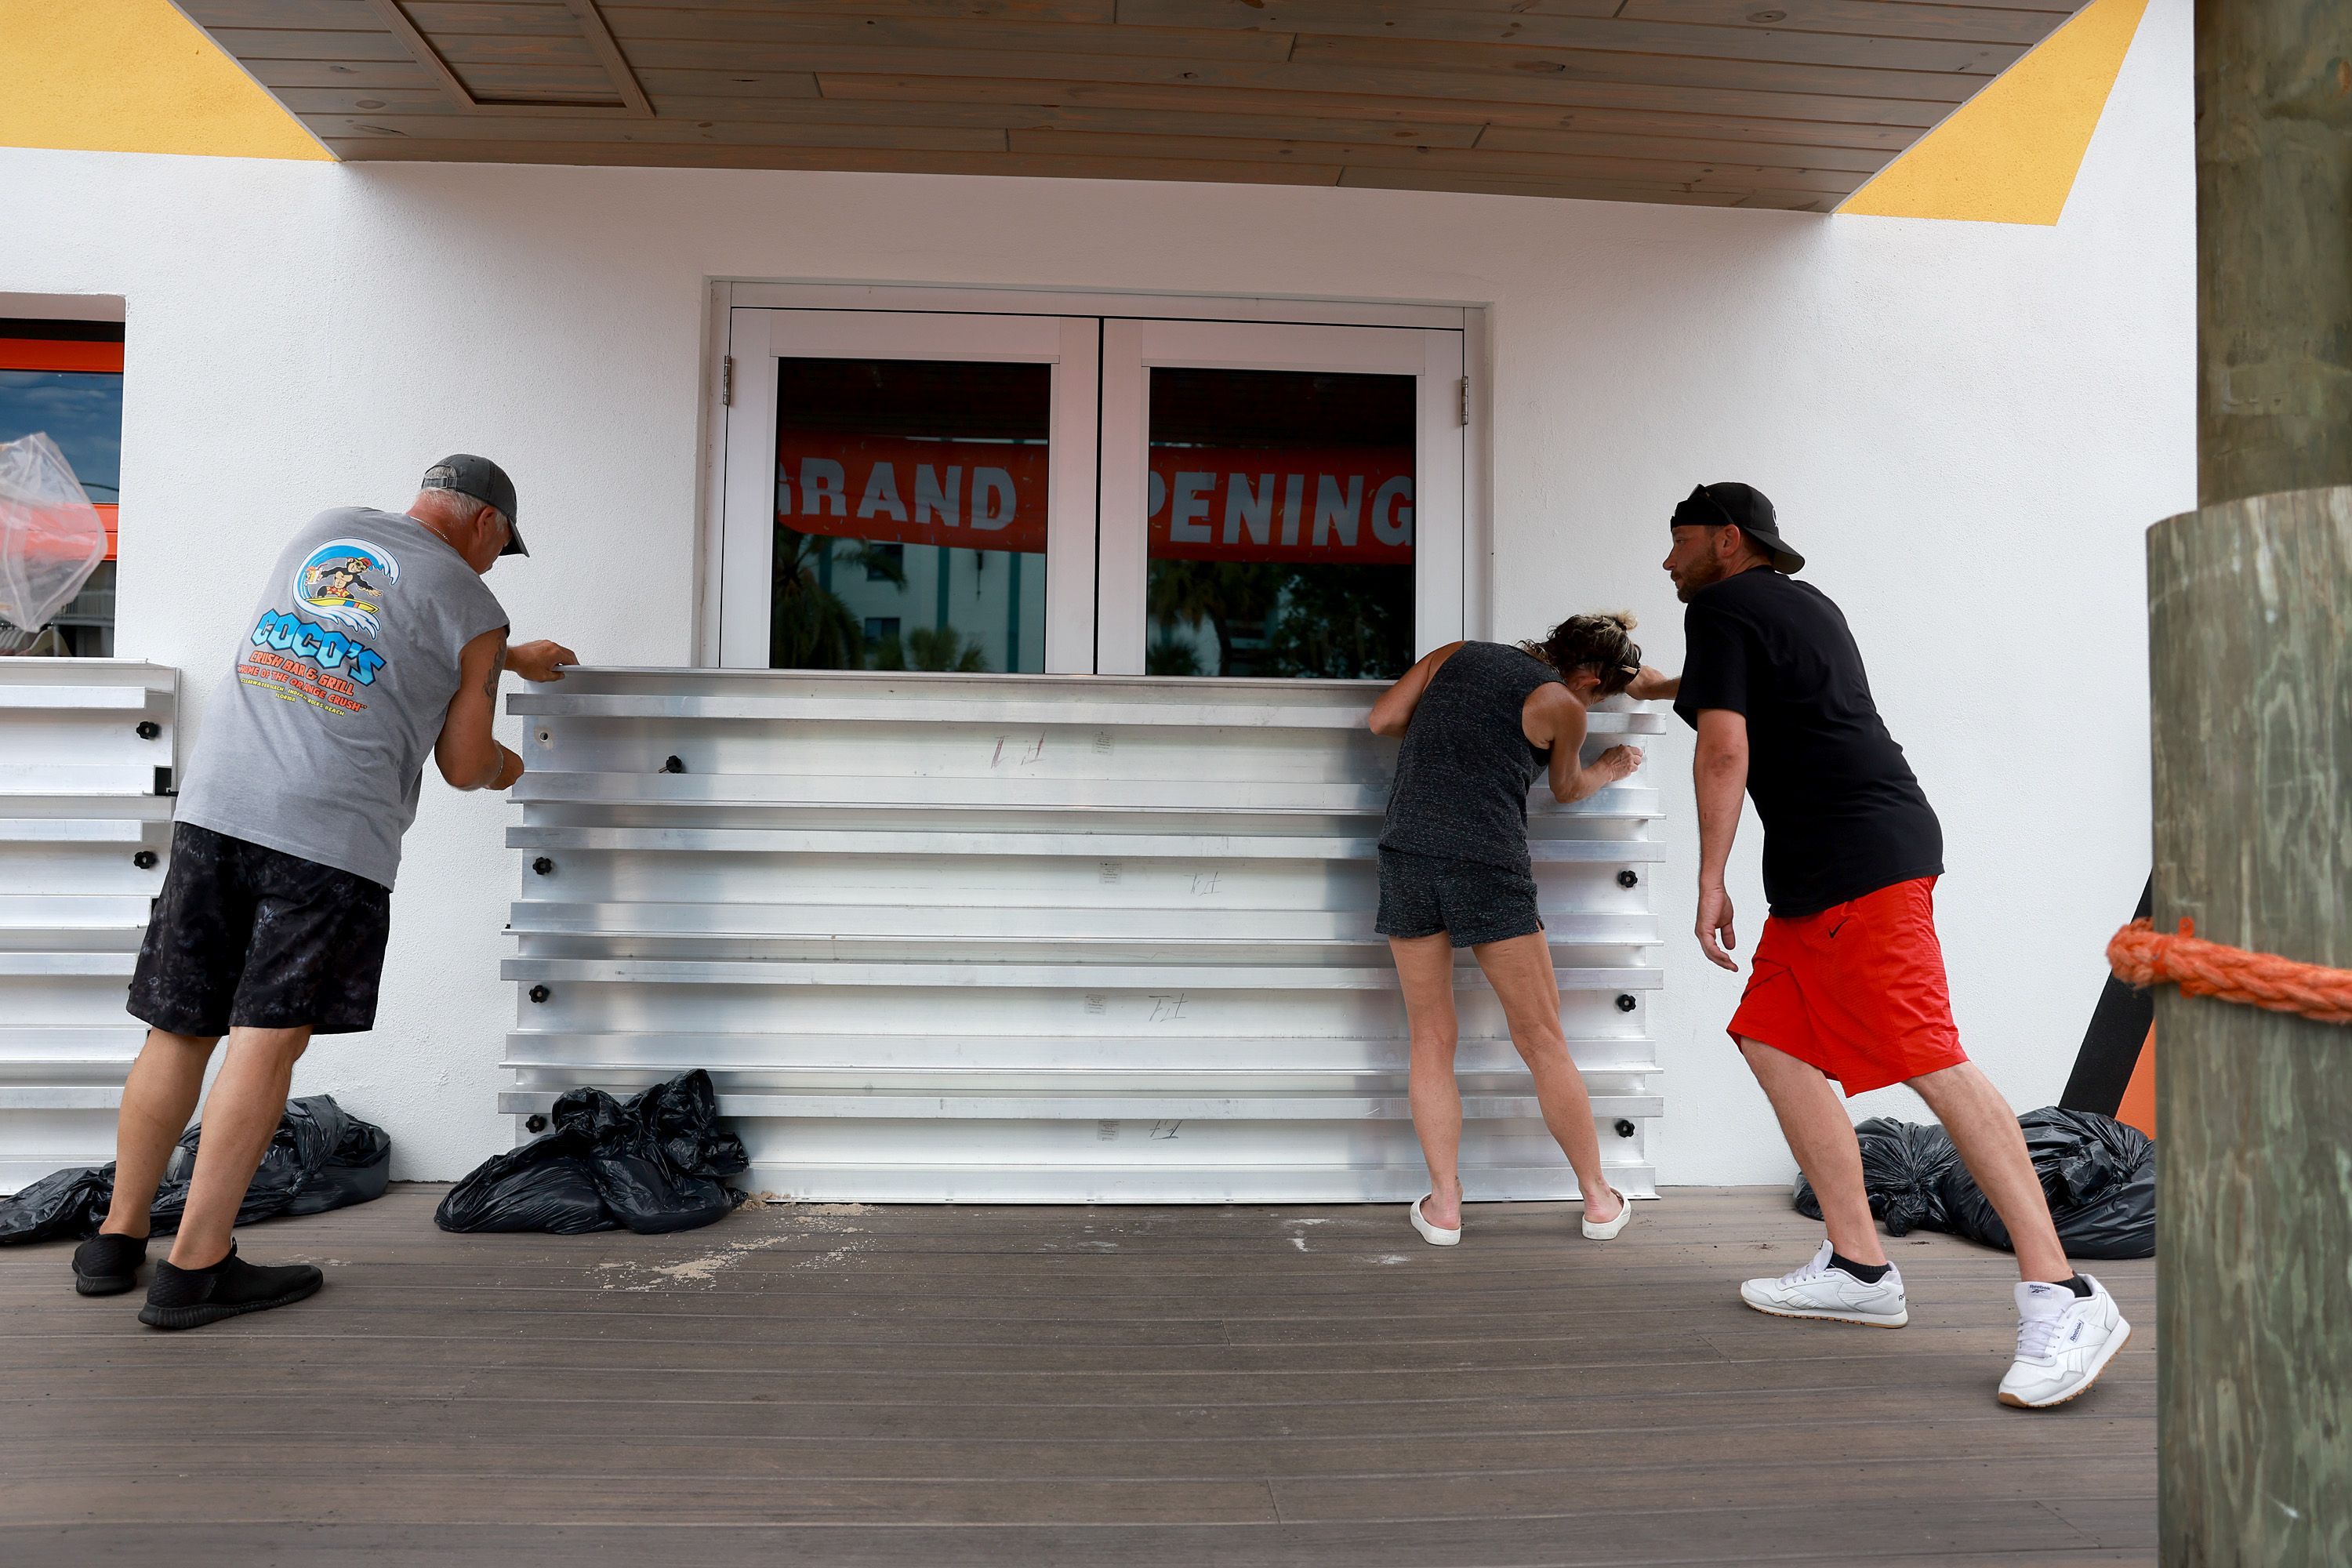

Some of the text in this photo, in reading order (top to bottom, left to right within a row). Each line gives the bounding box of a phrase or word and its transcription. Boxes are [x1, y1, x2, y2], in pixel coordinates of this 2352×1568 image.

[250, 608, 387, 687] COCO'S
[249, 650, 354, 696] CRUSH BAR & GRILL
[260, 668, 270, 679] OF
[270, 670, 289, 683] THE
[289, 677, 327, 699] ORANGE
[287, 688, 307, 701] INDIAN
[307, 698, 325, 709] ROCKS
[324, 703, 346, 717] BEACH
